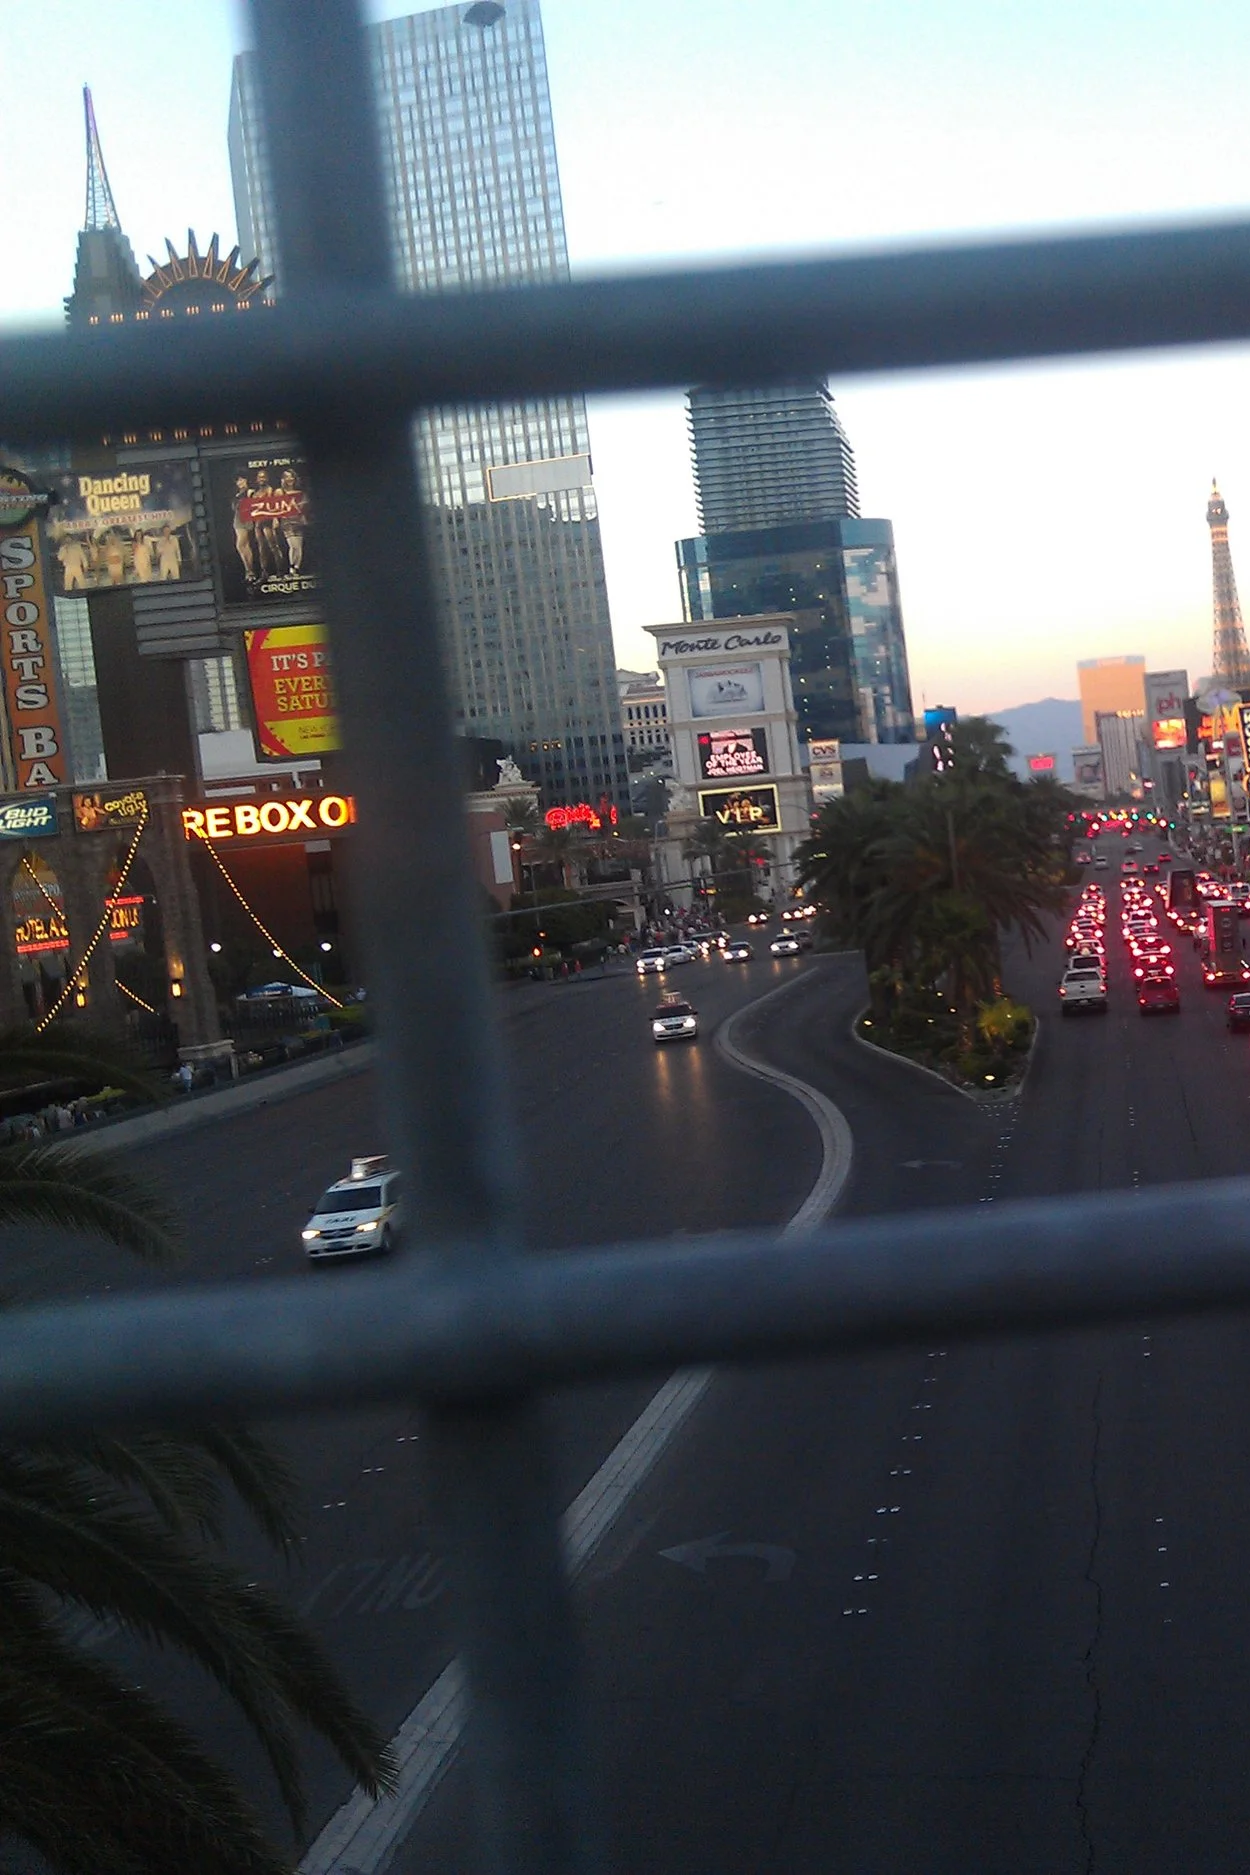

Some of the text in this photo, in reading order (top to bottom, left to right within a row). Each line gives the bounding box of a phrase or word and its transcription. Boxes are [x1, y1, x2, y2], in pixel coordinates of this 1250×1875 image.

[78, 472, 151, 497] Dancing
[86, 493, 141, 516] Queen
[260, 581, 300, 594] CIRQUE
[0, 534, 50, 711] SPORTS
[660, 630, 782, 656] Monte Carlo
[270, 653, 309, 672] IT'S
[273, 674, 333, 695] EVER
[276, 692, 335, 713] SATU
[17, 726, 59, 788] BA
[4, 806, 49, 820] BUD
